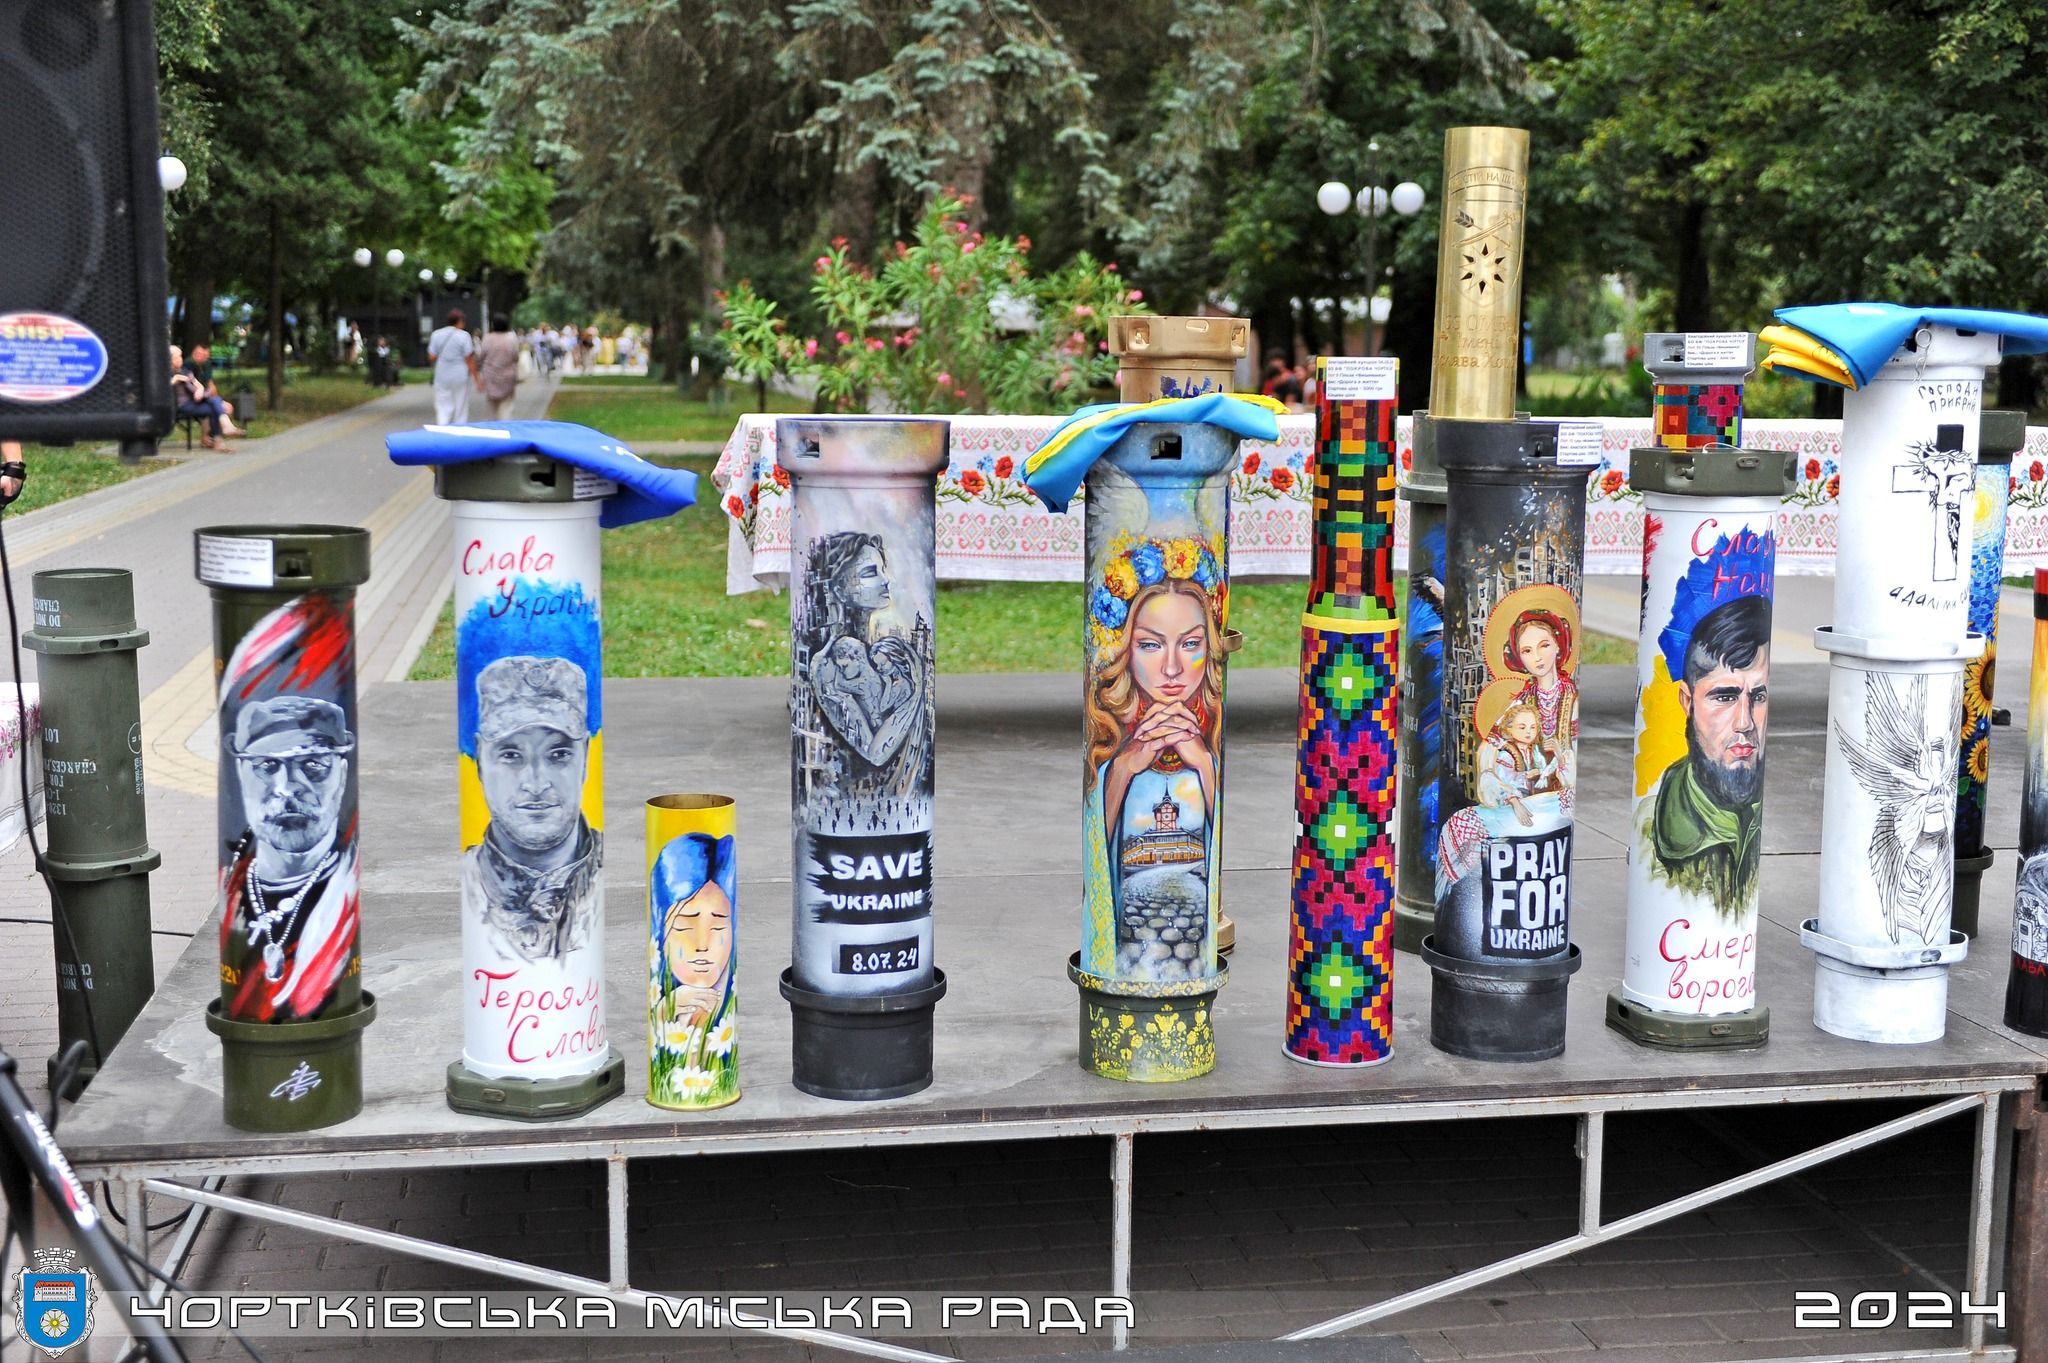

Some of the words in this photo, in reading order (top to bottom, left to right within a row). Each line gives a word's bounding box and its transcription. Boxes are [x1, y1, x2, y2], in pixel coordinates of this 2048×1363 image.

[463, 535, 555, 576] Слава
[830, 850, 923, 880] SAVE
[1490, 836, 1568, 880] PRAY
[831, 889, 923, 911] UKRAINE
[1491, 874, 1567, 930] FOR
[1490, 923, 1565, 951] UKRAINE
